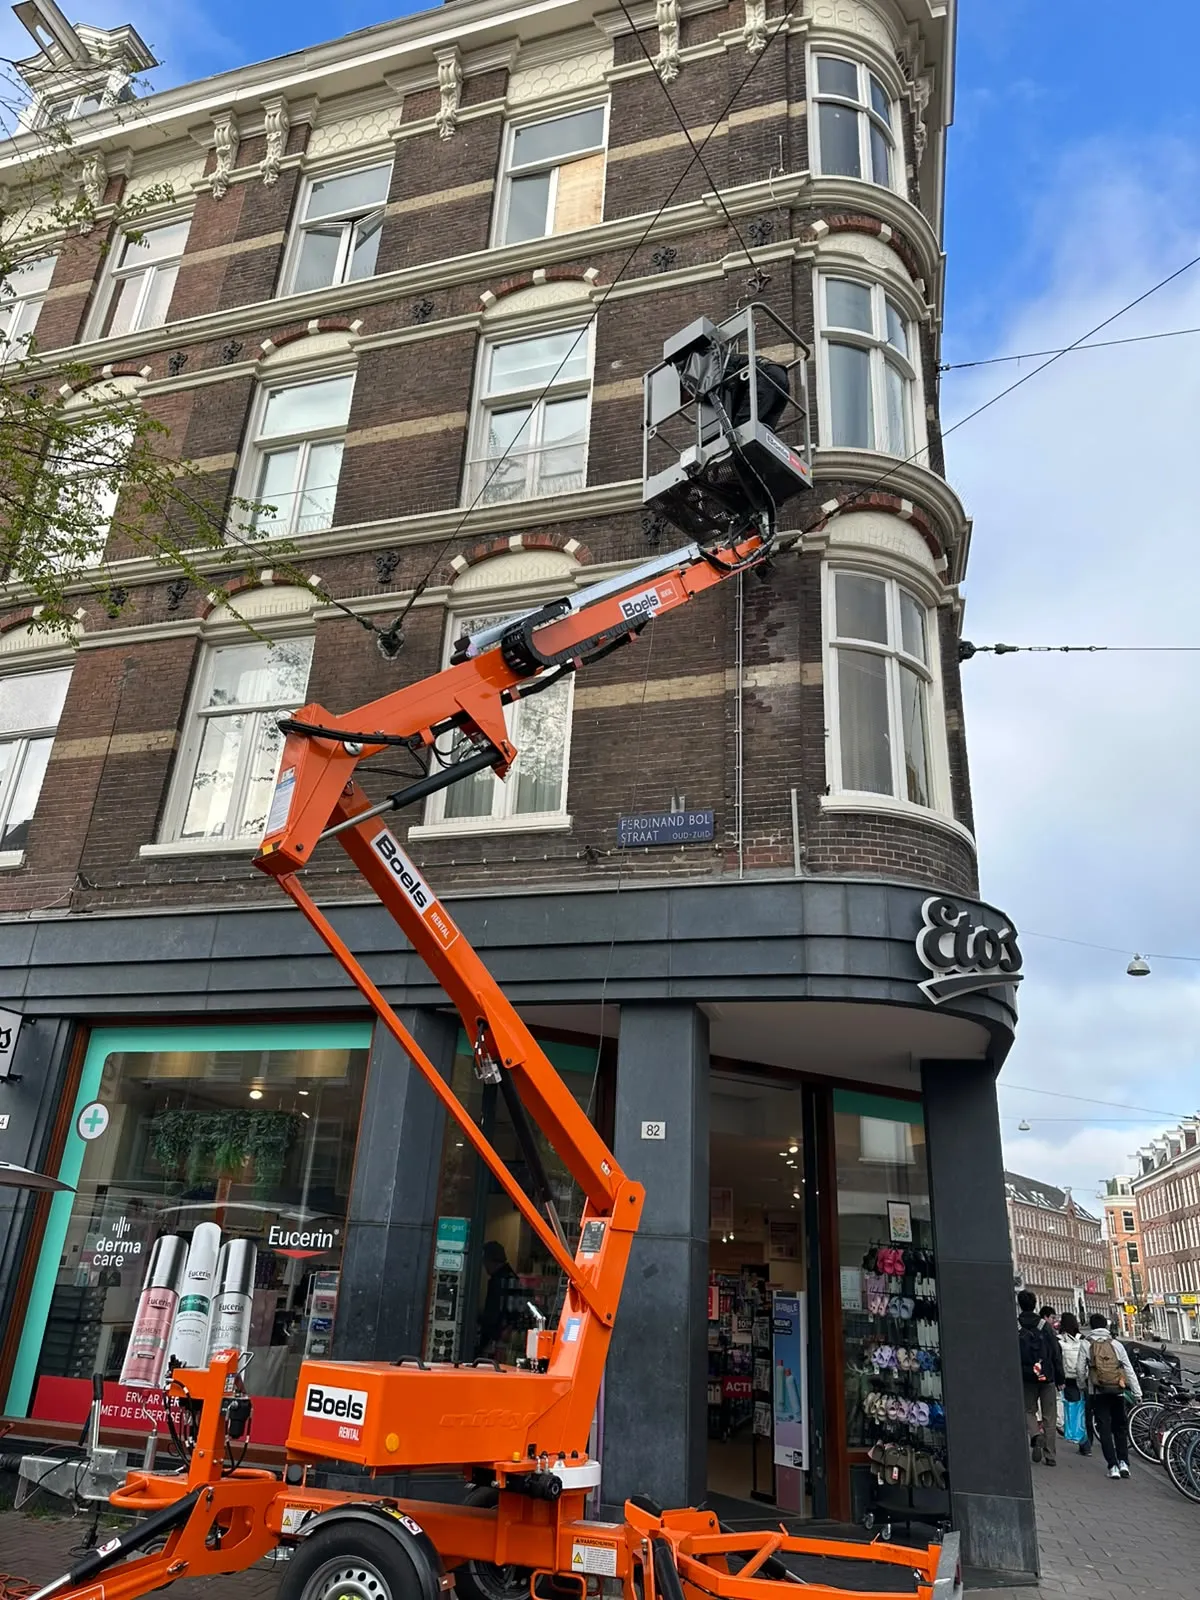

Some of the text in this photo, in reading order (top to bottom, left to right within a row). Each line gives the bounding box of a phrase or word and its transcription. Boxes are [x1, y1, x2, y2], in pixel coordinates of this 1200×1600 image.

[622, 594, 658, 617] Boels
[621, 814, 710, 830] FERDINAND BOL
[621, 830, 712, 843] STRAAT OUD-ZUID
[376, 834, 451, 939] Boels RENTAL
[916, 896, 1023, 974] Etos
[646, 1124, 660, 1136] 82
[268, 1225, 333, 1248] Eucerin
[96, 1237, 141, 1254] derma
[93, 1254, 124, 1267] care
[188, 1270, 211, 1278] Eucerin
[147, 1297, 172, 1307] Eucerin
[219, 1303, 244, 1312] Eucerin
[126, 1391, 160, 1405] ERVAR
[307, 1388, 363, 1420] Boels
[101, 1405, 119, 1417] MET
[120, 1407, 133, 1418] DE
[338, 1426, 359, 1441] RENTAL
